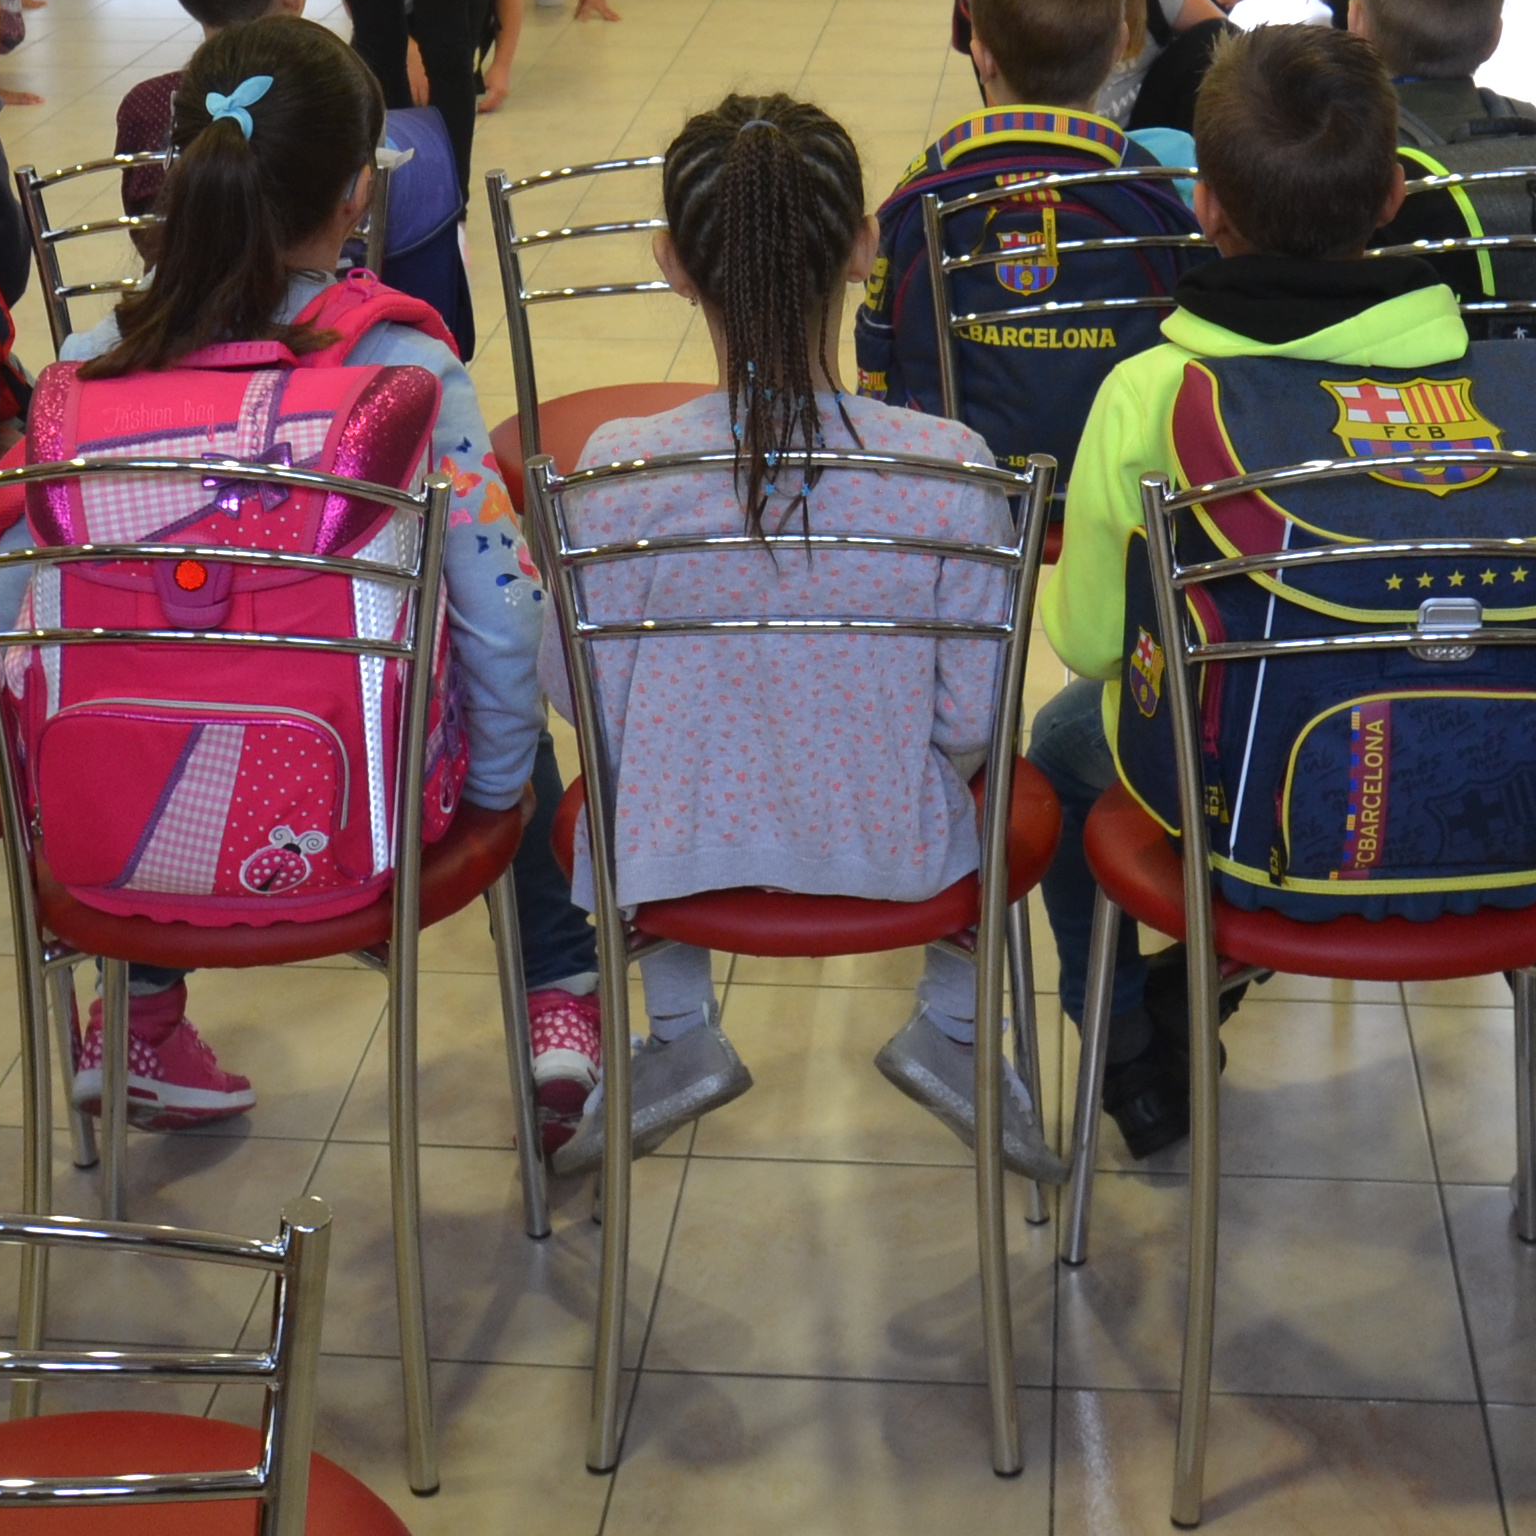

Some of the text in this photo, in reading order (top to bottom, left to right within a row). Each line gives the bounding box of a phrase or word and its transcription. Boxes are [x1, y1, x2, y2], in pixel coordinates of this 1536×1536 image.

[955, 324, 1117, 348] CBARCELONA
[1383, 426, 1446, 439] FCB
[1208, 785, 1220, 817] FCB
